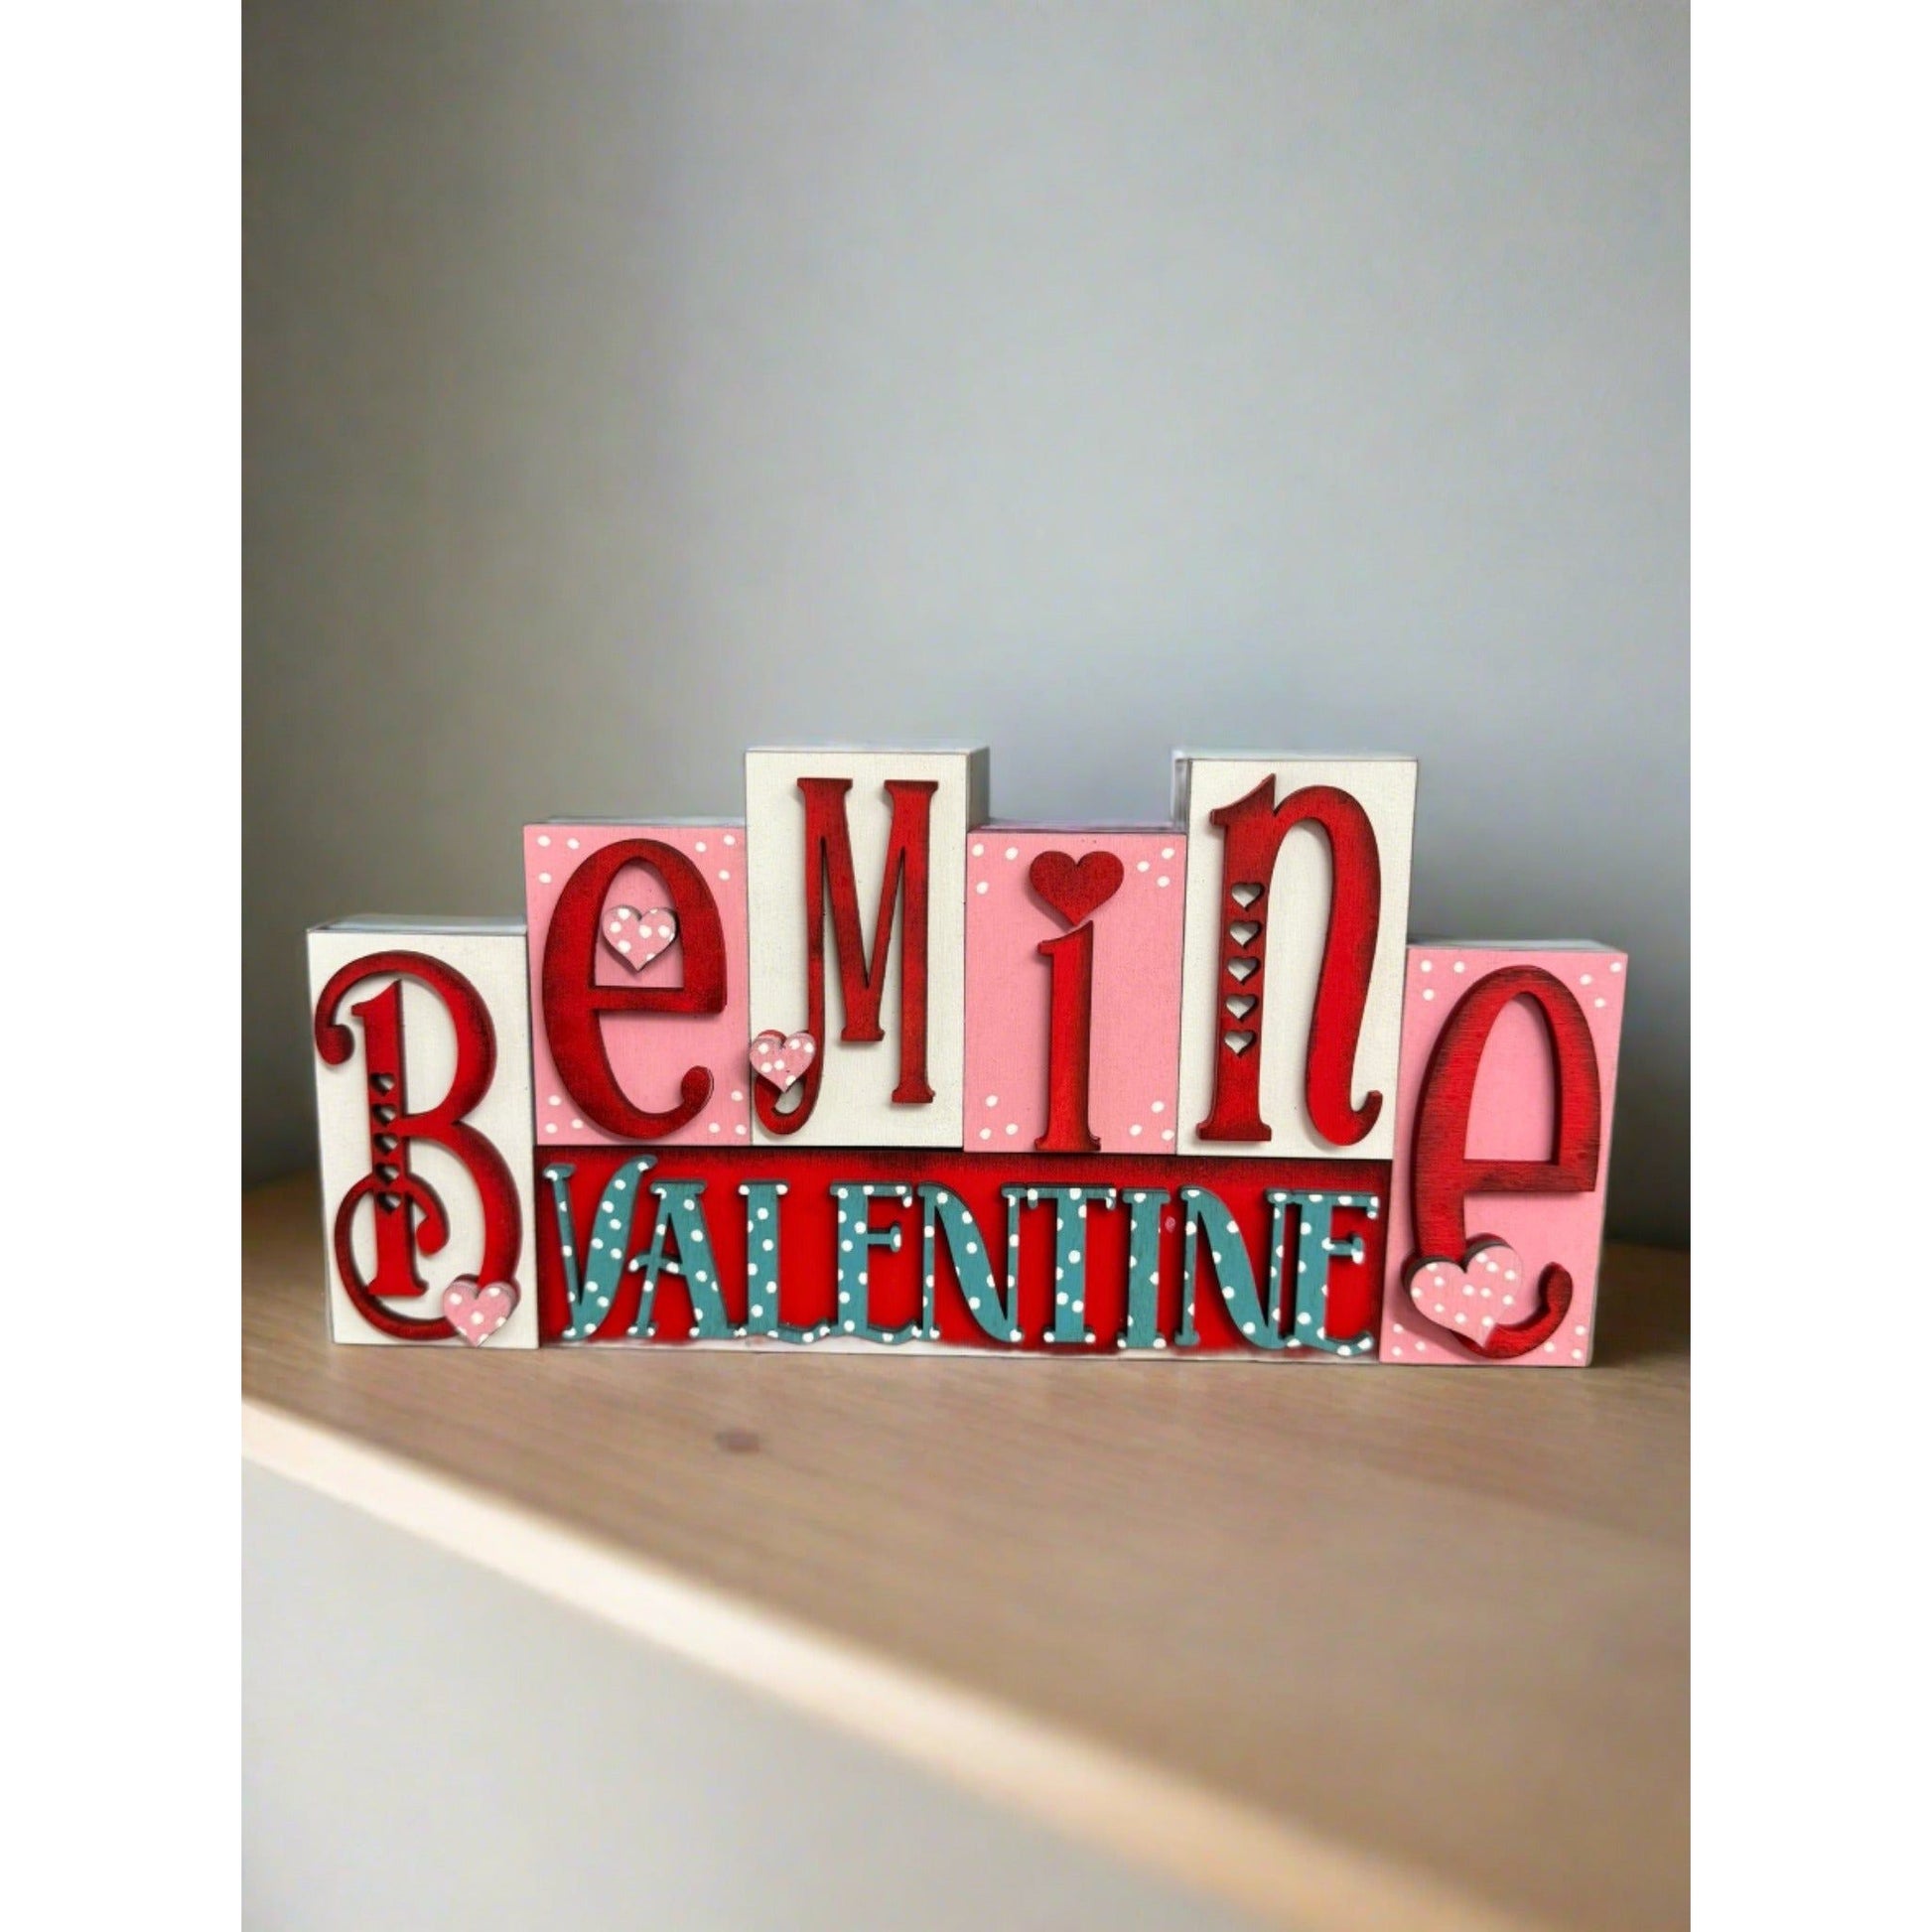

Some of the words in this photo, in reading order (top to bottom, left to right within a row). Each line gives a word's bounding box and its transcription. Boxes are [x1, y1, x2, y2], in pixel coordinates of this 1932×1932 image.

[315, 838, 728, 1341] Be
[752, 773, 1602, 1359] Mine
[542, 1155, 1380, 1357] VALENTINE
